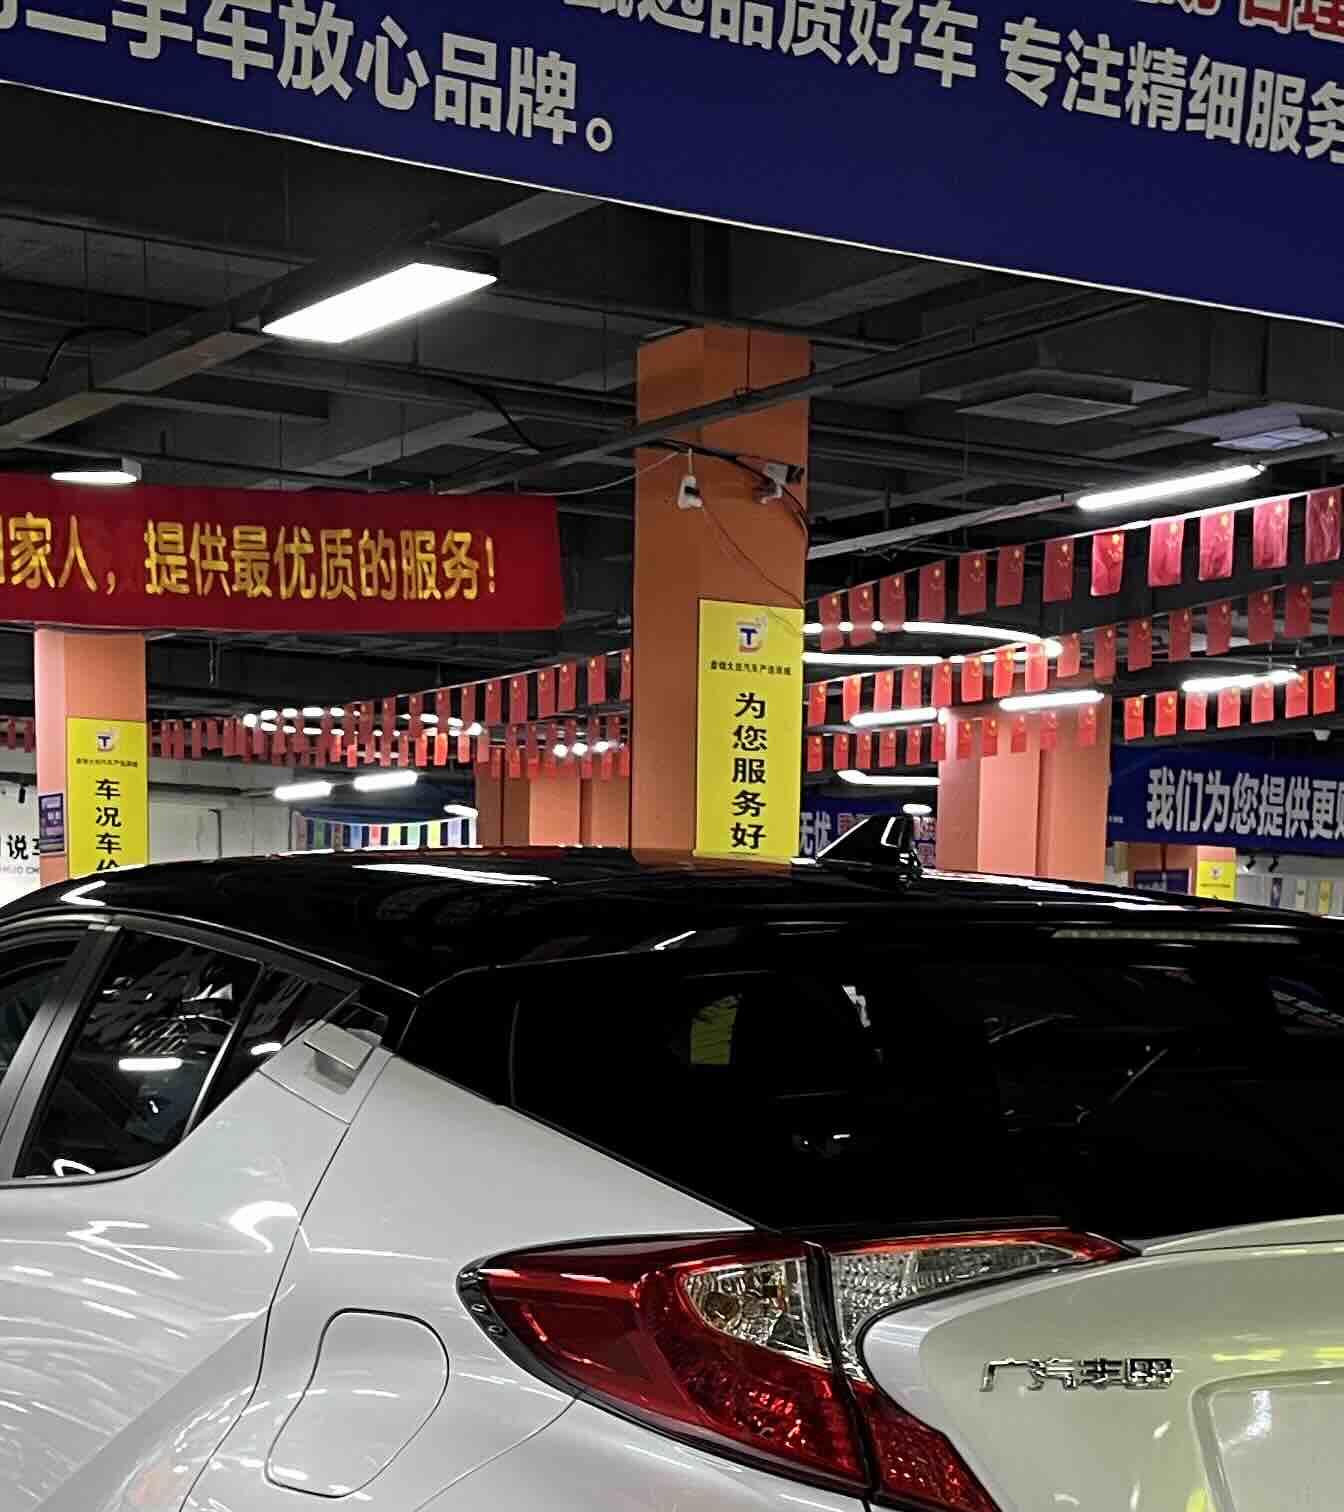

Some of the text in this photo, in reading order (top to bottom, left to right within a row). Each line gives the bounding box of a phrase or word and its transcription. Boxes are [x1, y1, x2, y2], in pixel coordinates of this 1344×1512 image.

[730, 691, 768, 850] 为您服务好
[979, 1357, 1175, 1393] 广汽丰田
